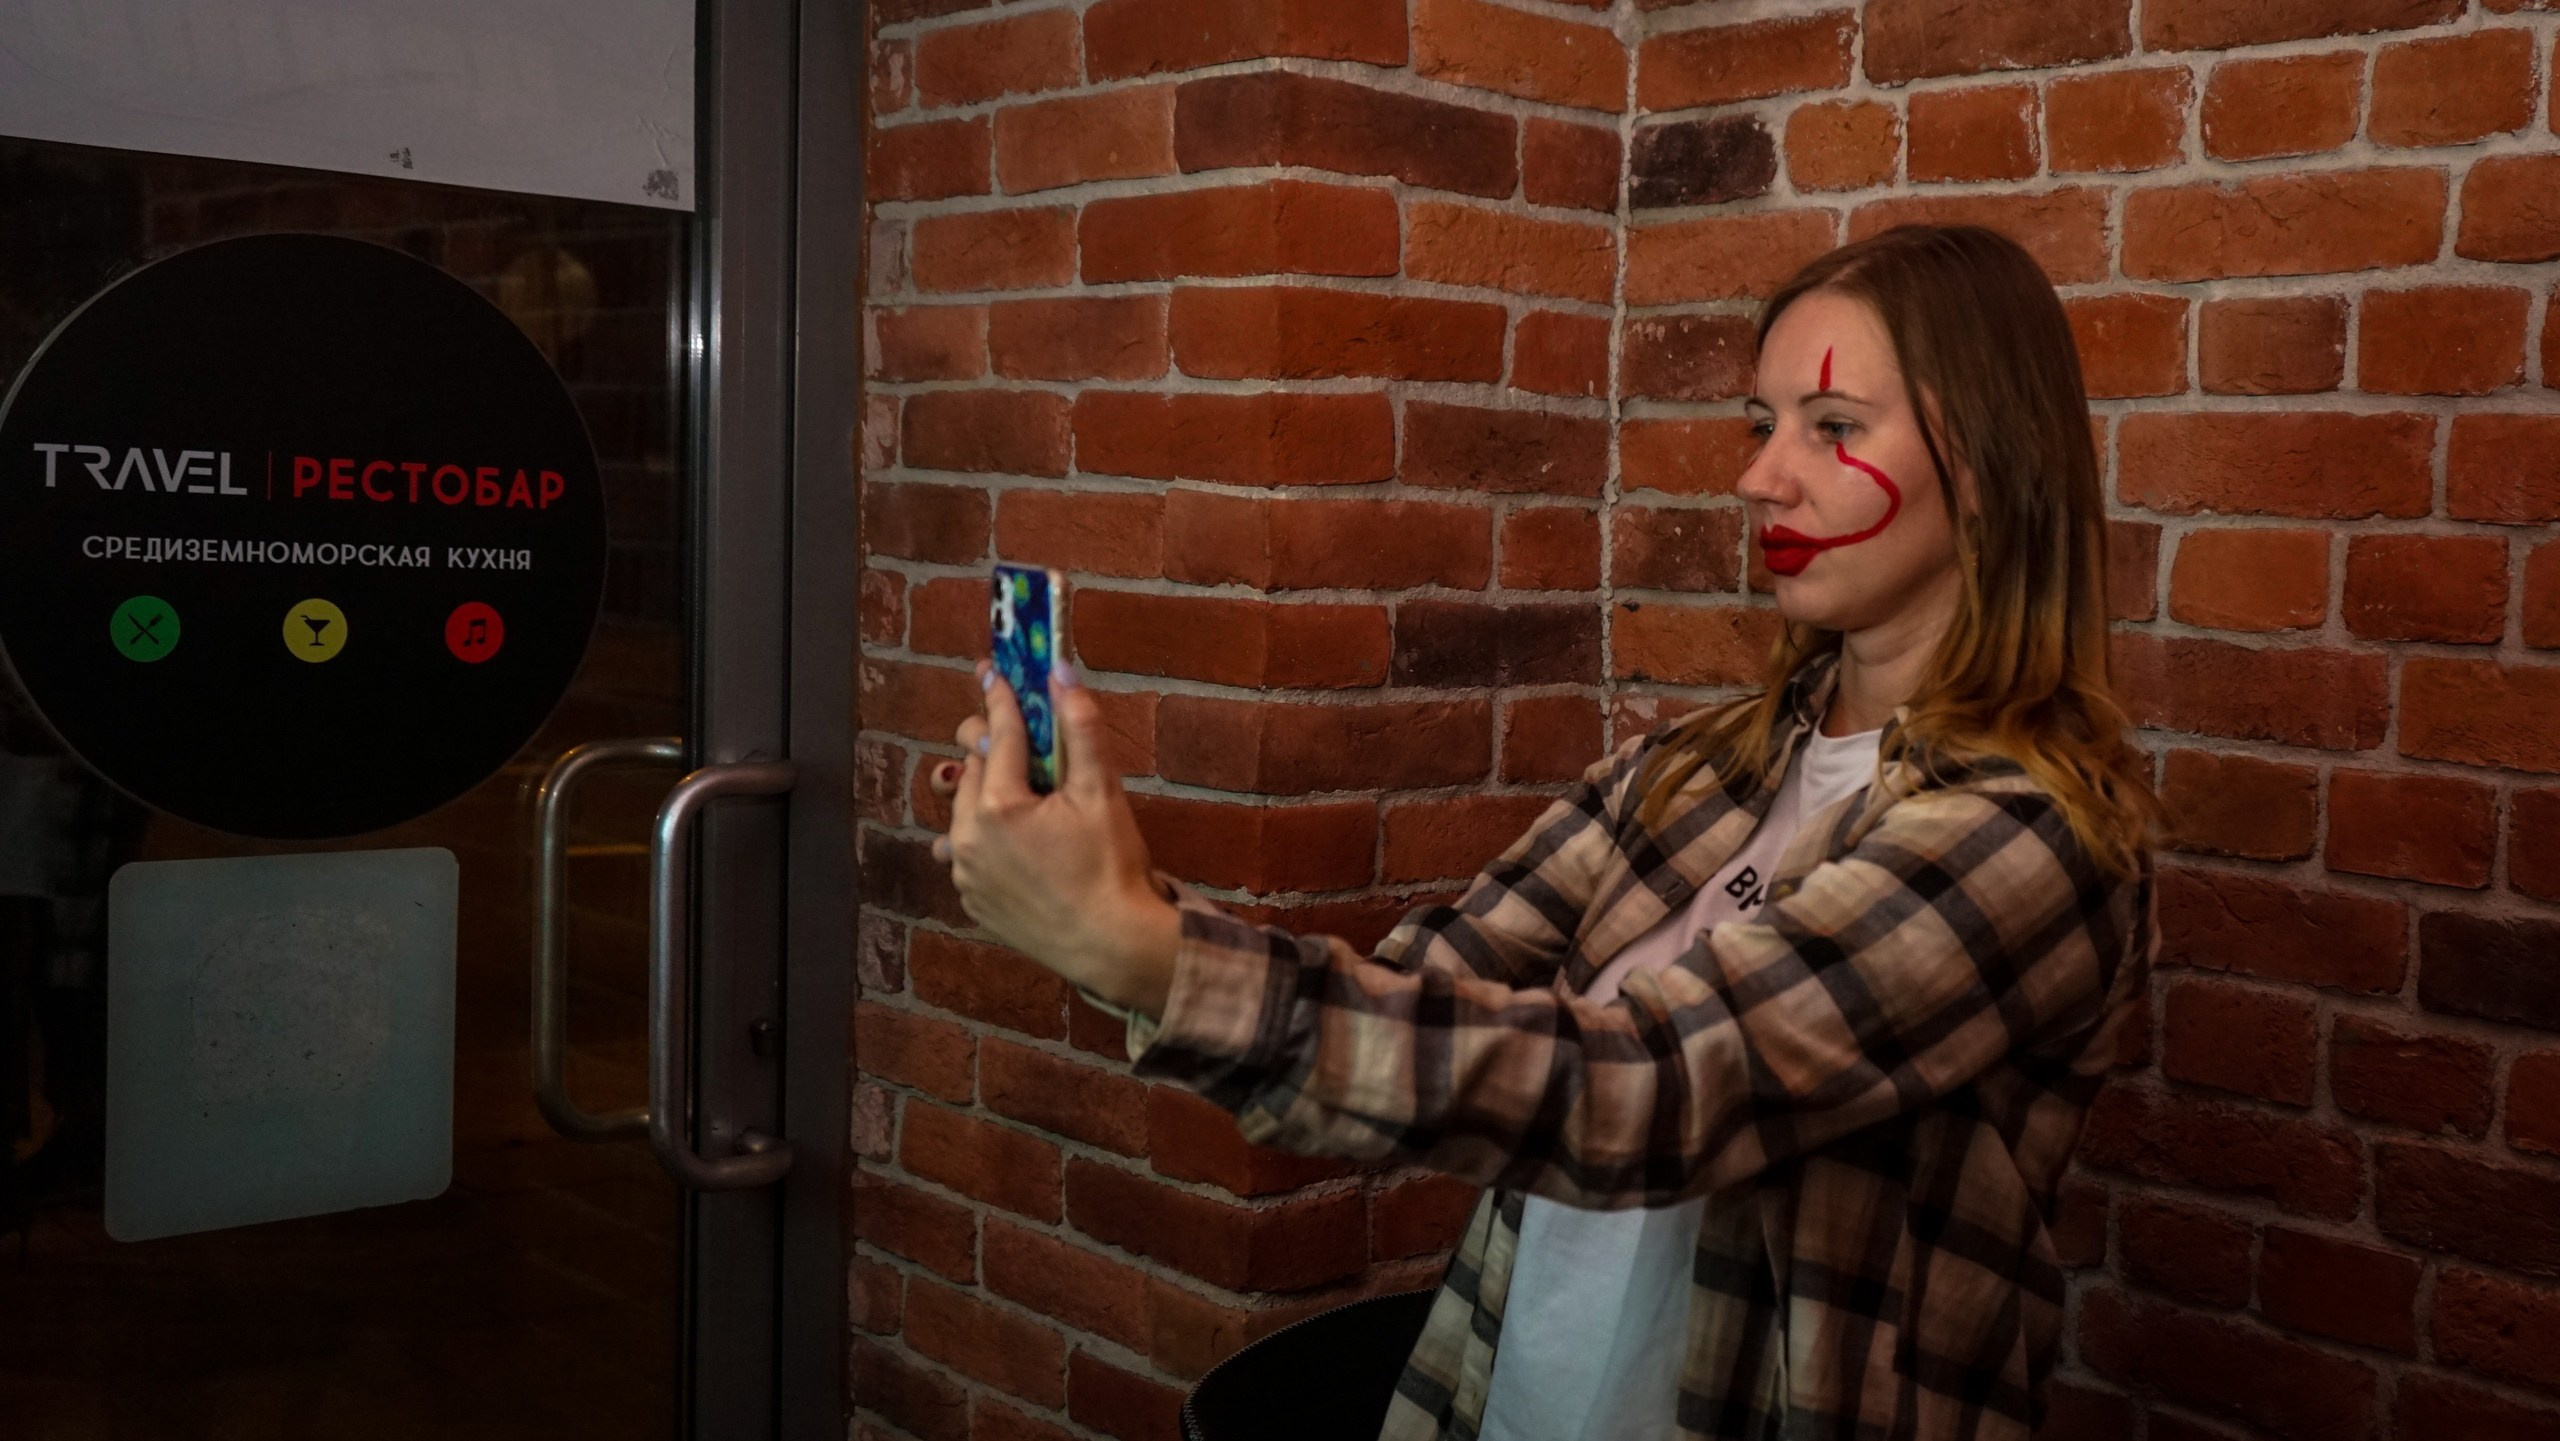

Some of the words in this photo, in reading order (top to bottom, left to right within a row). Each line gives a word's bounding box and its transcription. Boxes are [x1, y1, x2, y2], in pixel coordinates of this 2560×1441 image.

[33, 442, 248, 496] TRAVEL
[292, 456, 565, 509] РЕСТОБАР
[82, 535, 431, 568] СРЕДИЗЕМНОМОРСКАЯ
[447, 547, 531, 571] КУХНЯ
